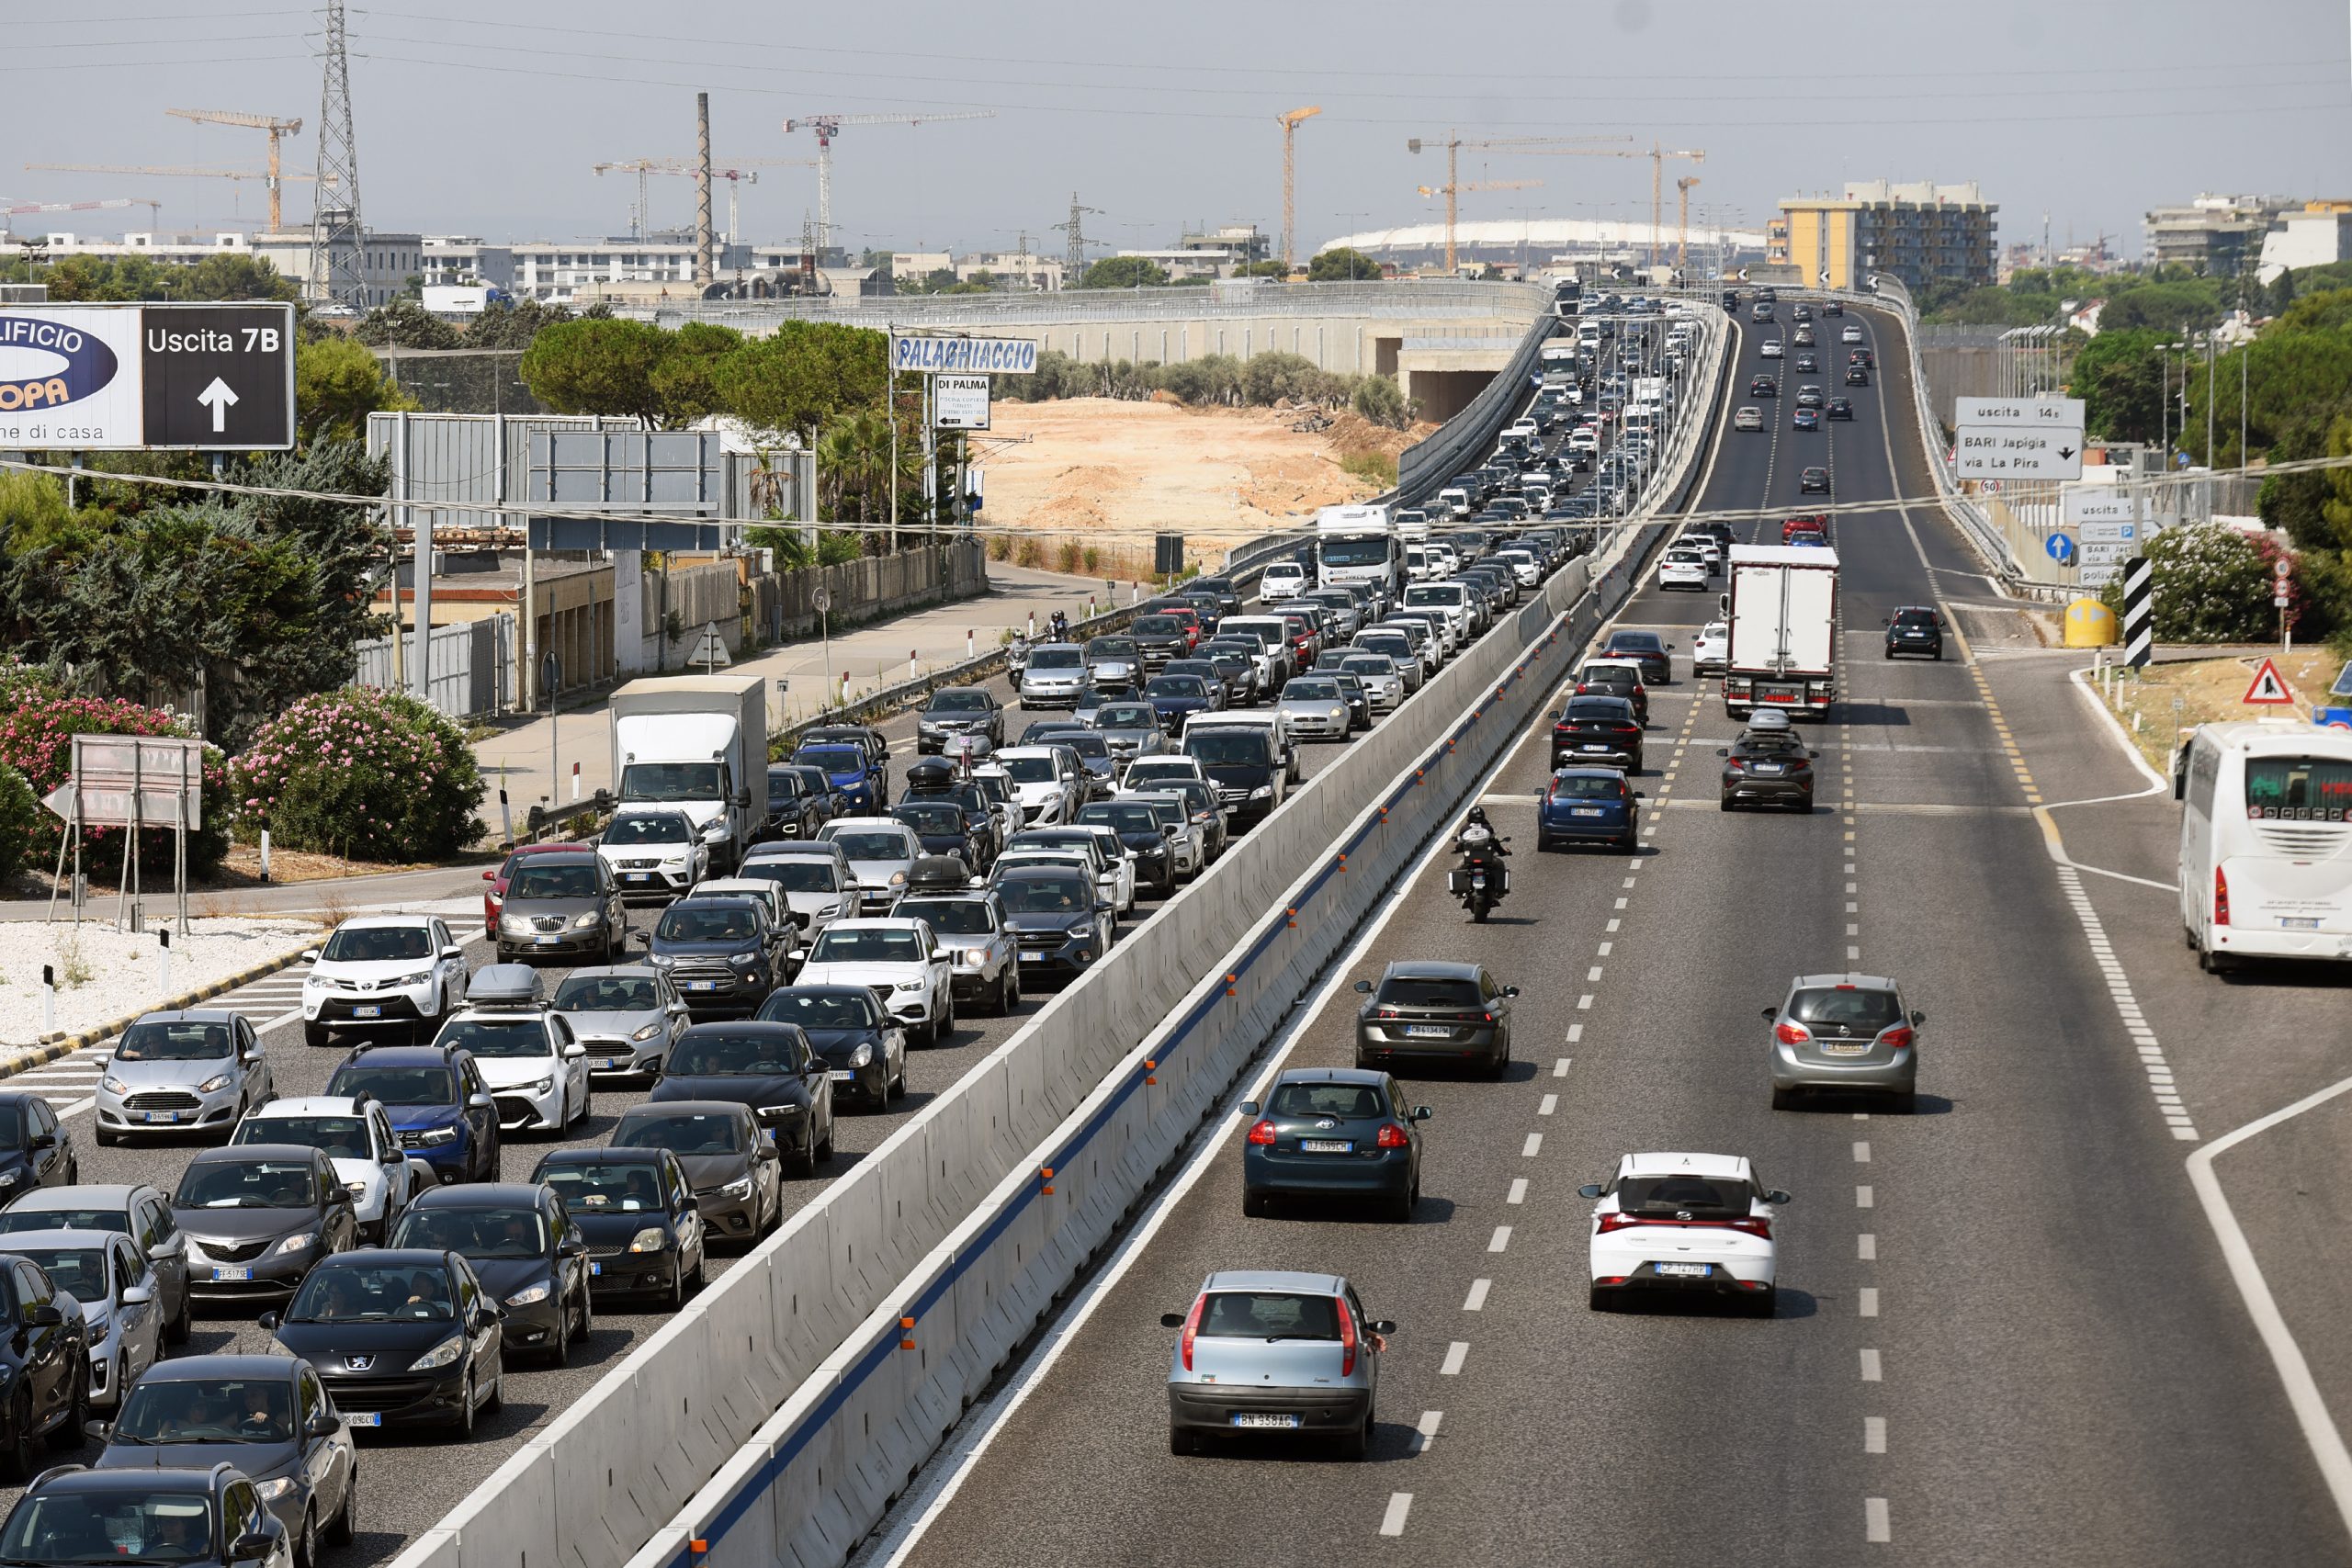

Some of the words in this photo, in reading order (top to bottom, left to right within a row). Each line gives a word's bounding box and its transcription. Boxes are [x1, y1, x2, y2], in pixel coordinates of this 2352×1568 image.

[0, 321, 83, 353] IFICIO
[147, 328, 232, 353] Uscita
[241, 328, 280, 353] 7B
[898, 339, 1035, 370] PALAGHIACCIO
[938, 379, 949, 389] DI
[953, 379, 987, 389] PALMA
[1977, 406, 2020, 417] uscita
[29, 424, 47, 439] di
[57, 427, 104, 439] casa
[1964, 436, 1996, 447] BARI
[1964, 457, 1983, 468] via
[1991, 457, 2007, 468] La
[2013, 457, 2039, 468] Pira
[2082, 504, 2119, 514] uscita
[1241, 1415, 1255, 1427] BN
